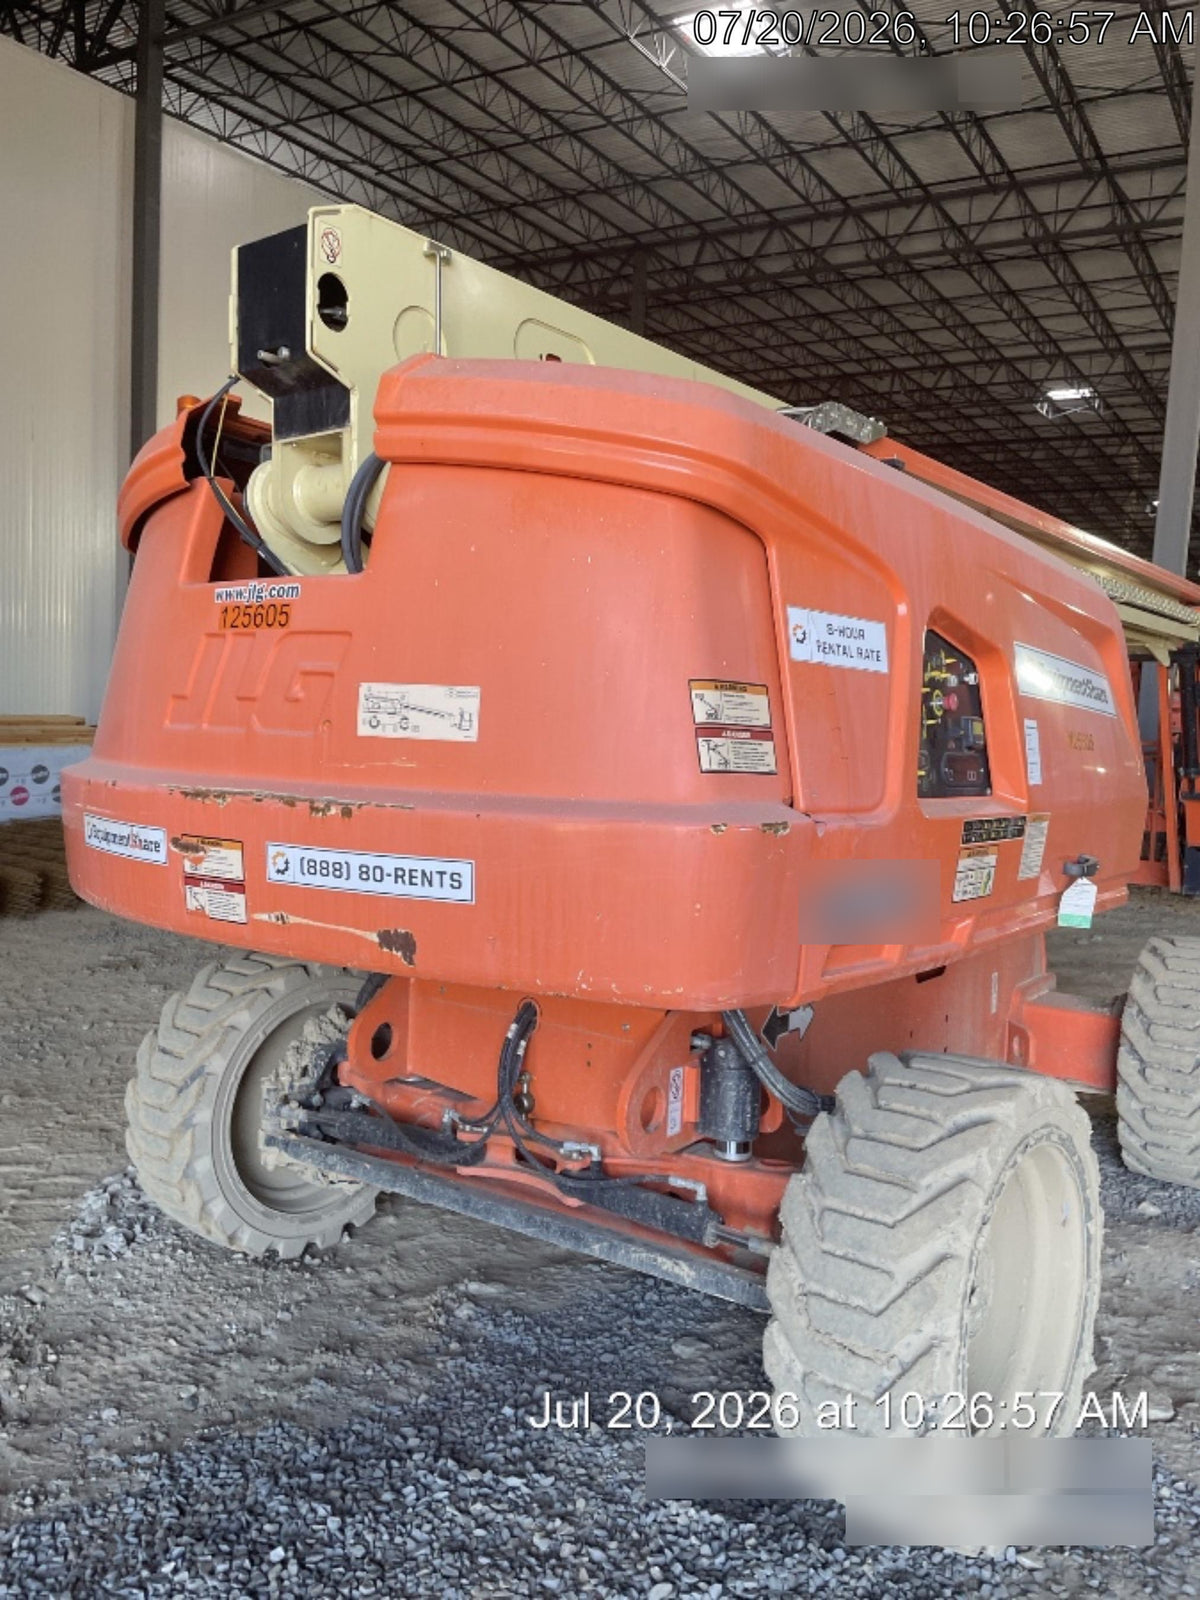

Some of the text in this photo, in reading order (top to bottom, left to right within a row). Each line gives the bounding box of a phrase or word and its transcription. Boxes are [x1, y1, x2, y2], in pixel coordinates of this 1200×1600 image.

[215, 583, 299, 603] www.jlg.com
[221, 603, 290, 629] 125605
[299, 856, 464, 890] (888) 80-RENTS
